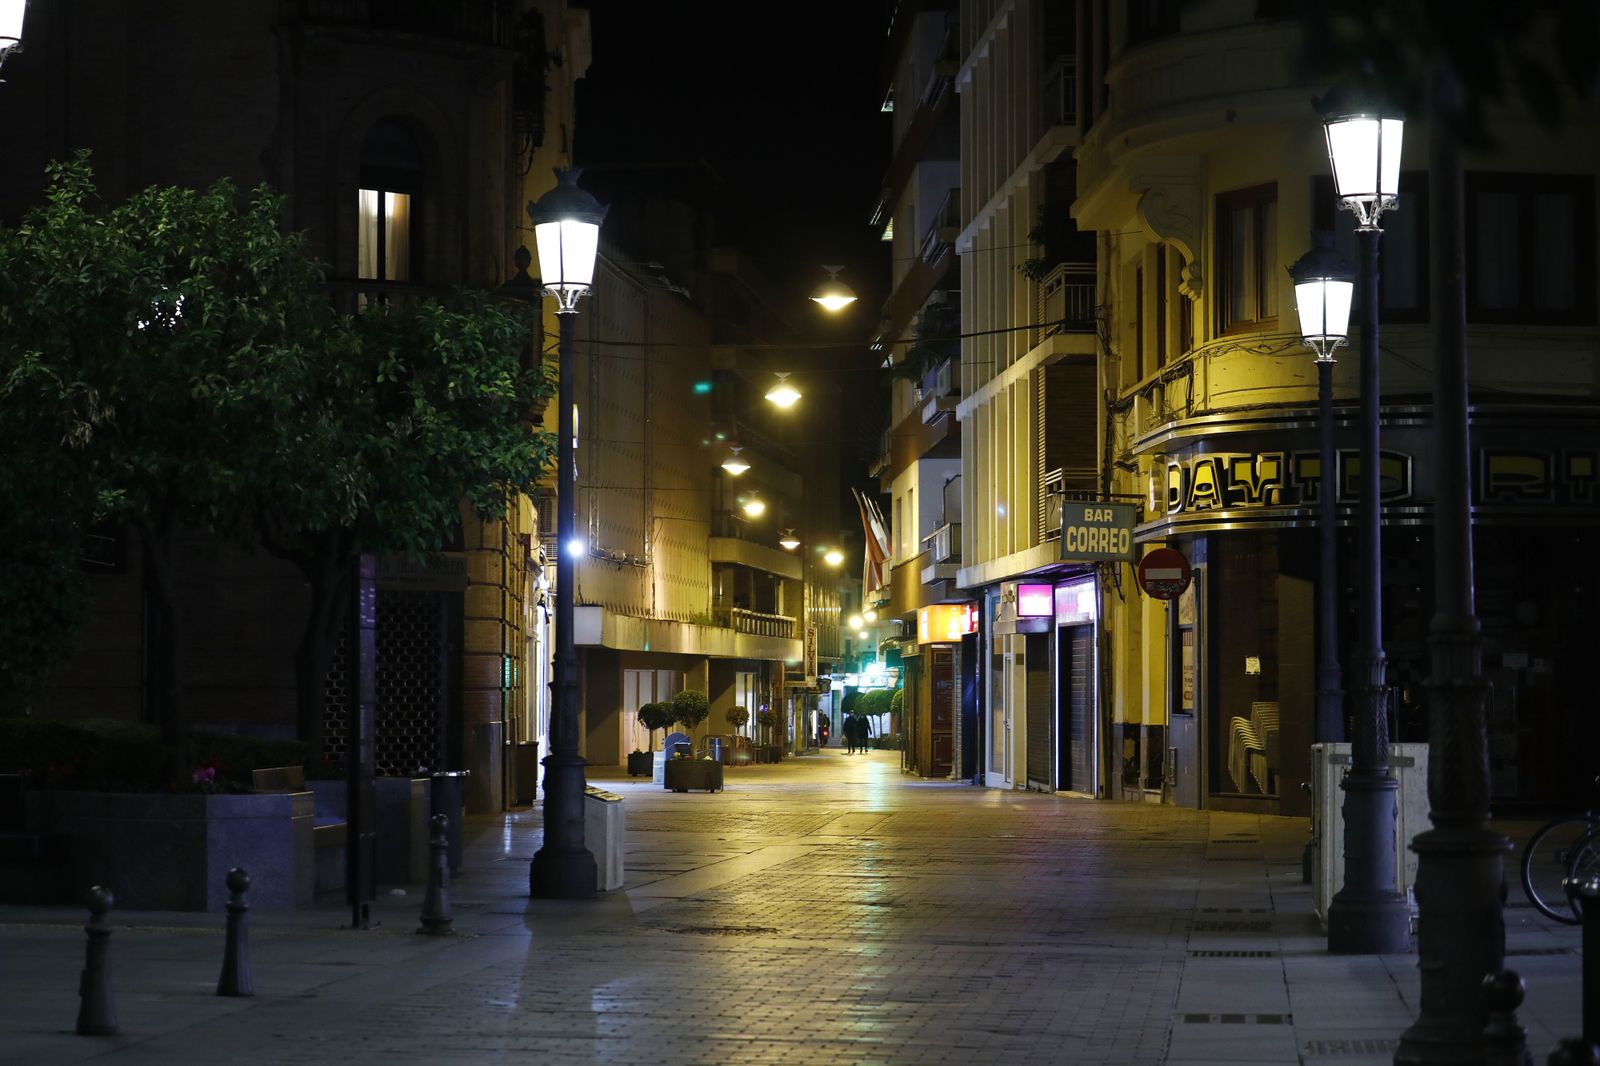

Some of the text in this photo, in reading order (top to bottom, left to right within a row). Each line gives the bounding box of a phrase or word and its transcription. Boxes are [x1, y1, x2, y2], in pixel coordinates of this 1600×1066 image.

[1084, 508, 1113, 522] BAR
[1066, 525, 1130, 554] CORREO
[807, 628, 816, 677] SILVIA
